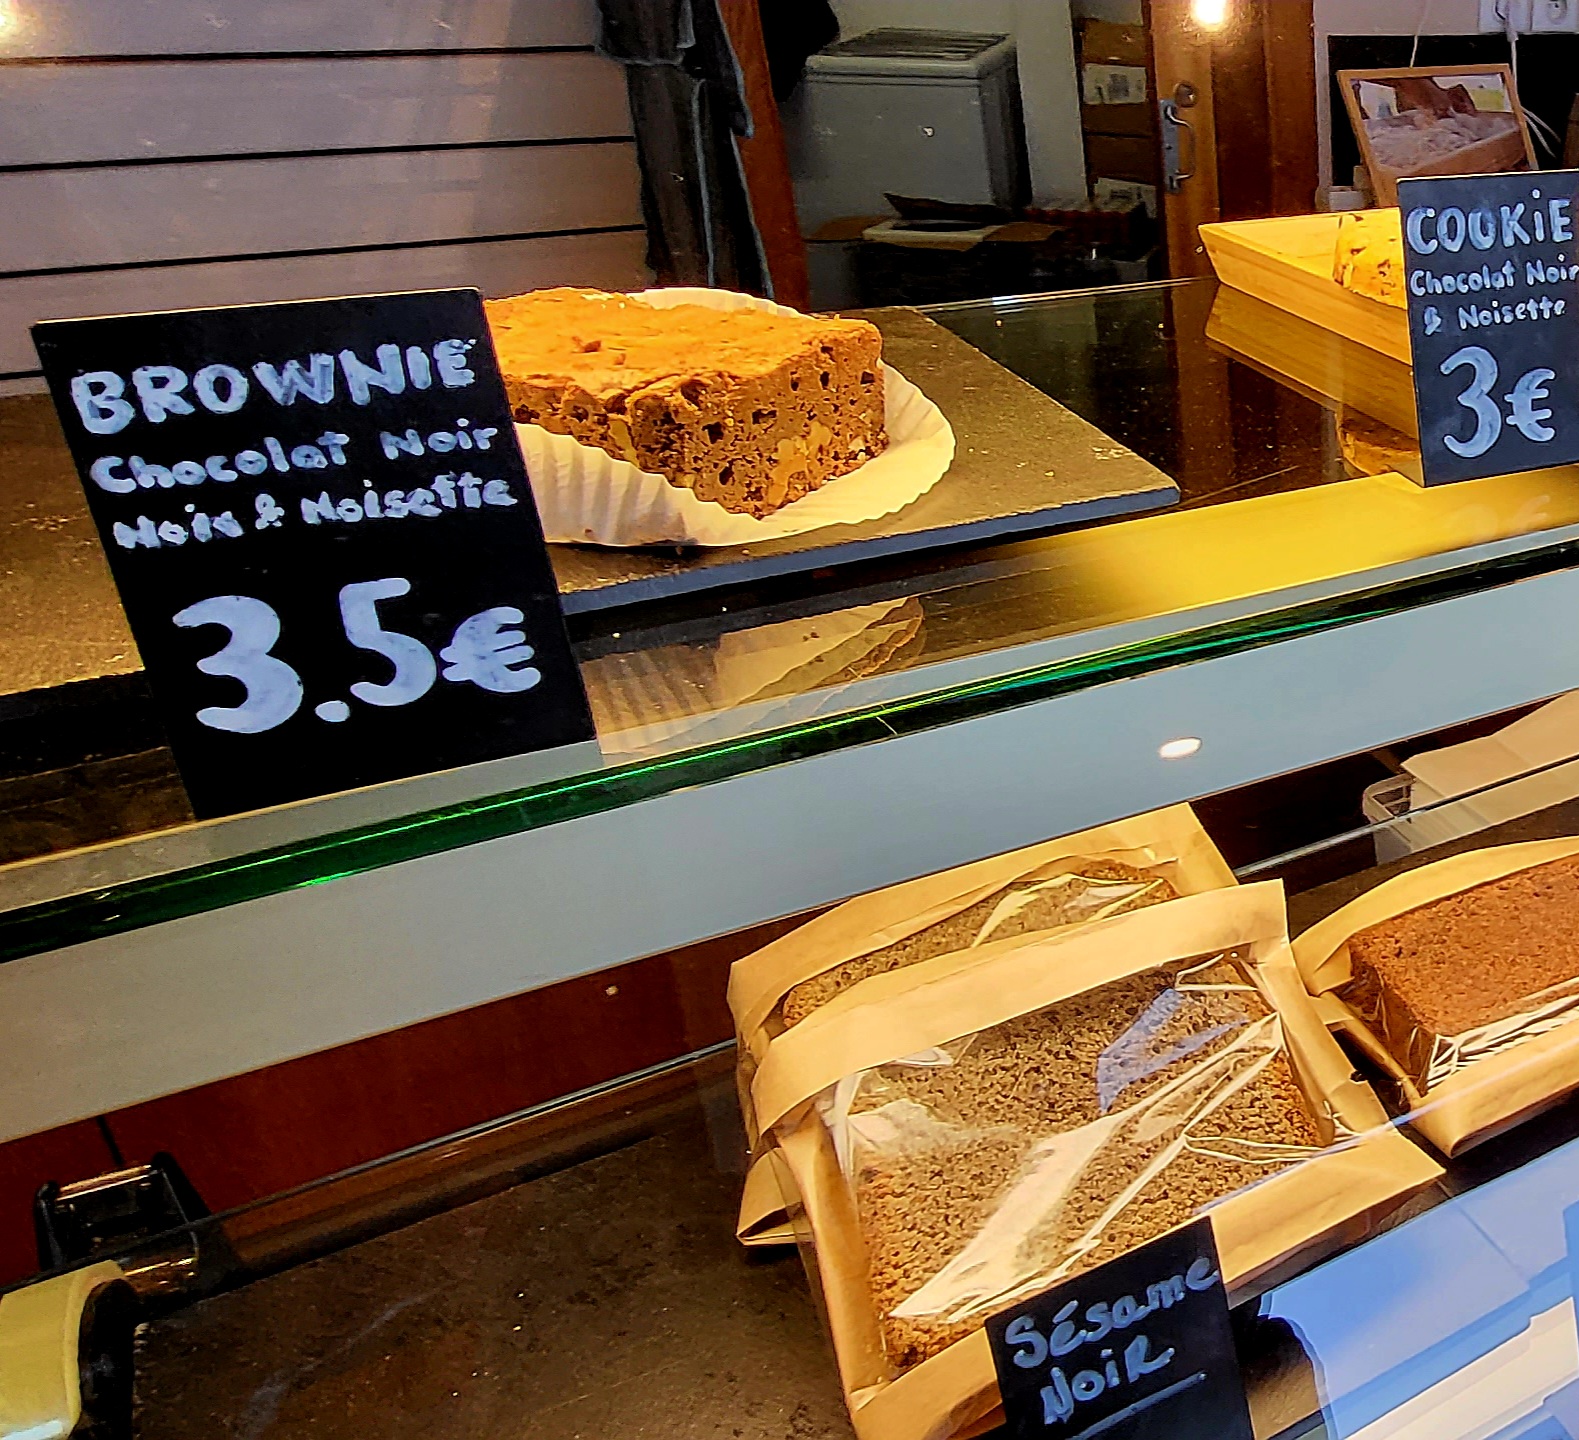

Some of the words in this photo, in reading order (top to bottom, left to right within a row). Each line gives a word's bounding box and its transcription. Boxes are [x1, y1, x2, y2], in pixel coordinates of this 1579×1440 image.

[1411, 260, 1516, 296] Chocolat
[1526, 254, 1579, 286] Noir
[1458, 296, 1566, 331] Noisette
[71, 338, 477, 434] BROWNIE
[1440, 346, 1556, 458] 3€
[91, 430, 349, 493] Chocolat
[380, 418, 498, 460] Noir
[255, 493, 285, 530] &
[301, 472, 518, 525] Noisette
[172, 577, 541, 733] 3.5€
[1004, 1254, 1220, 1369] Sésame
